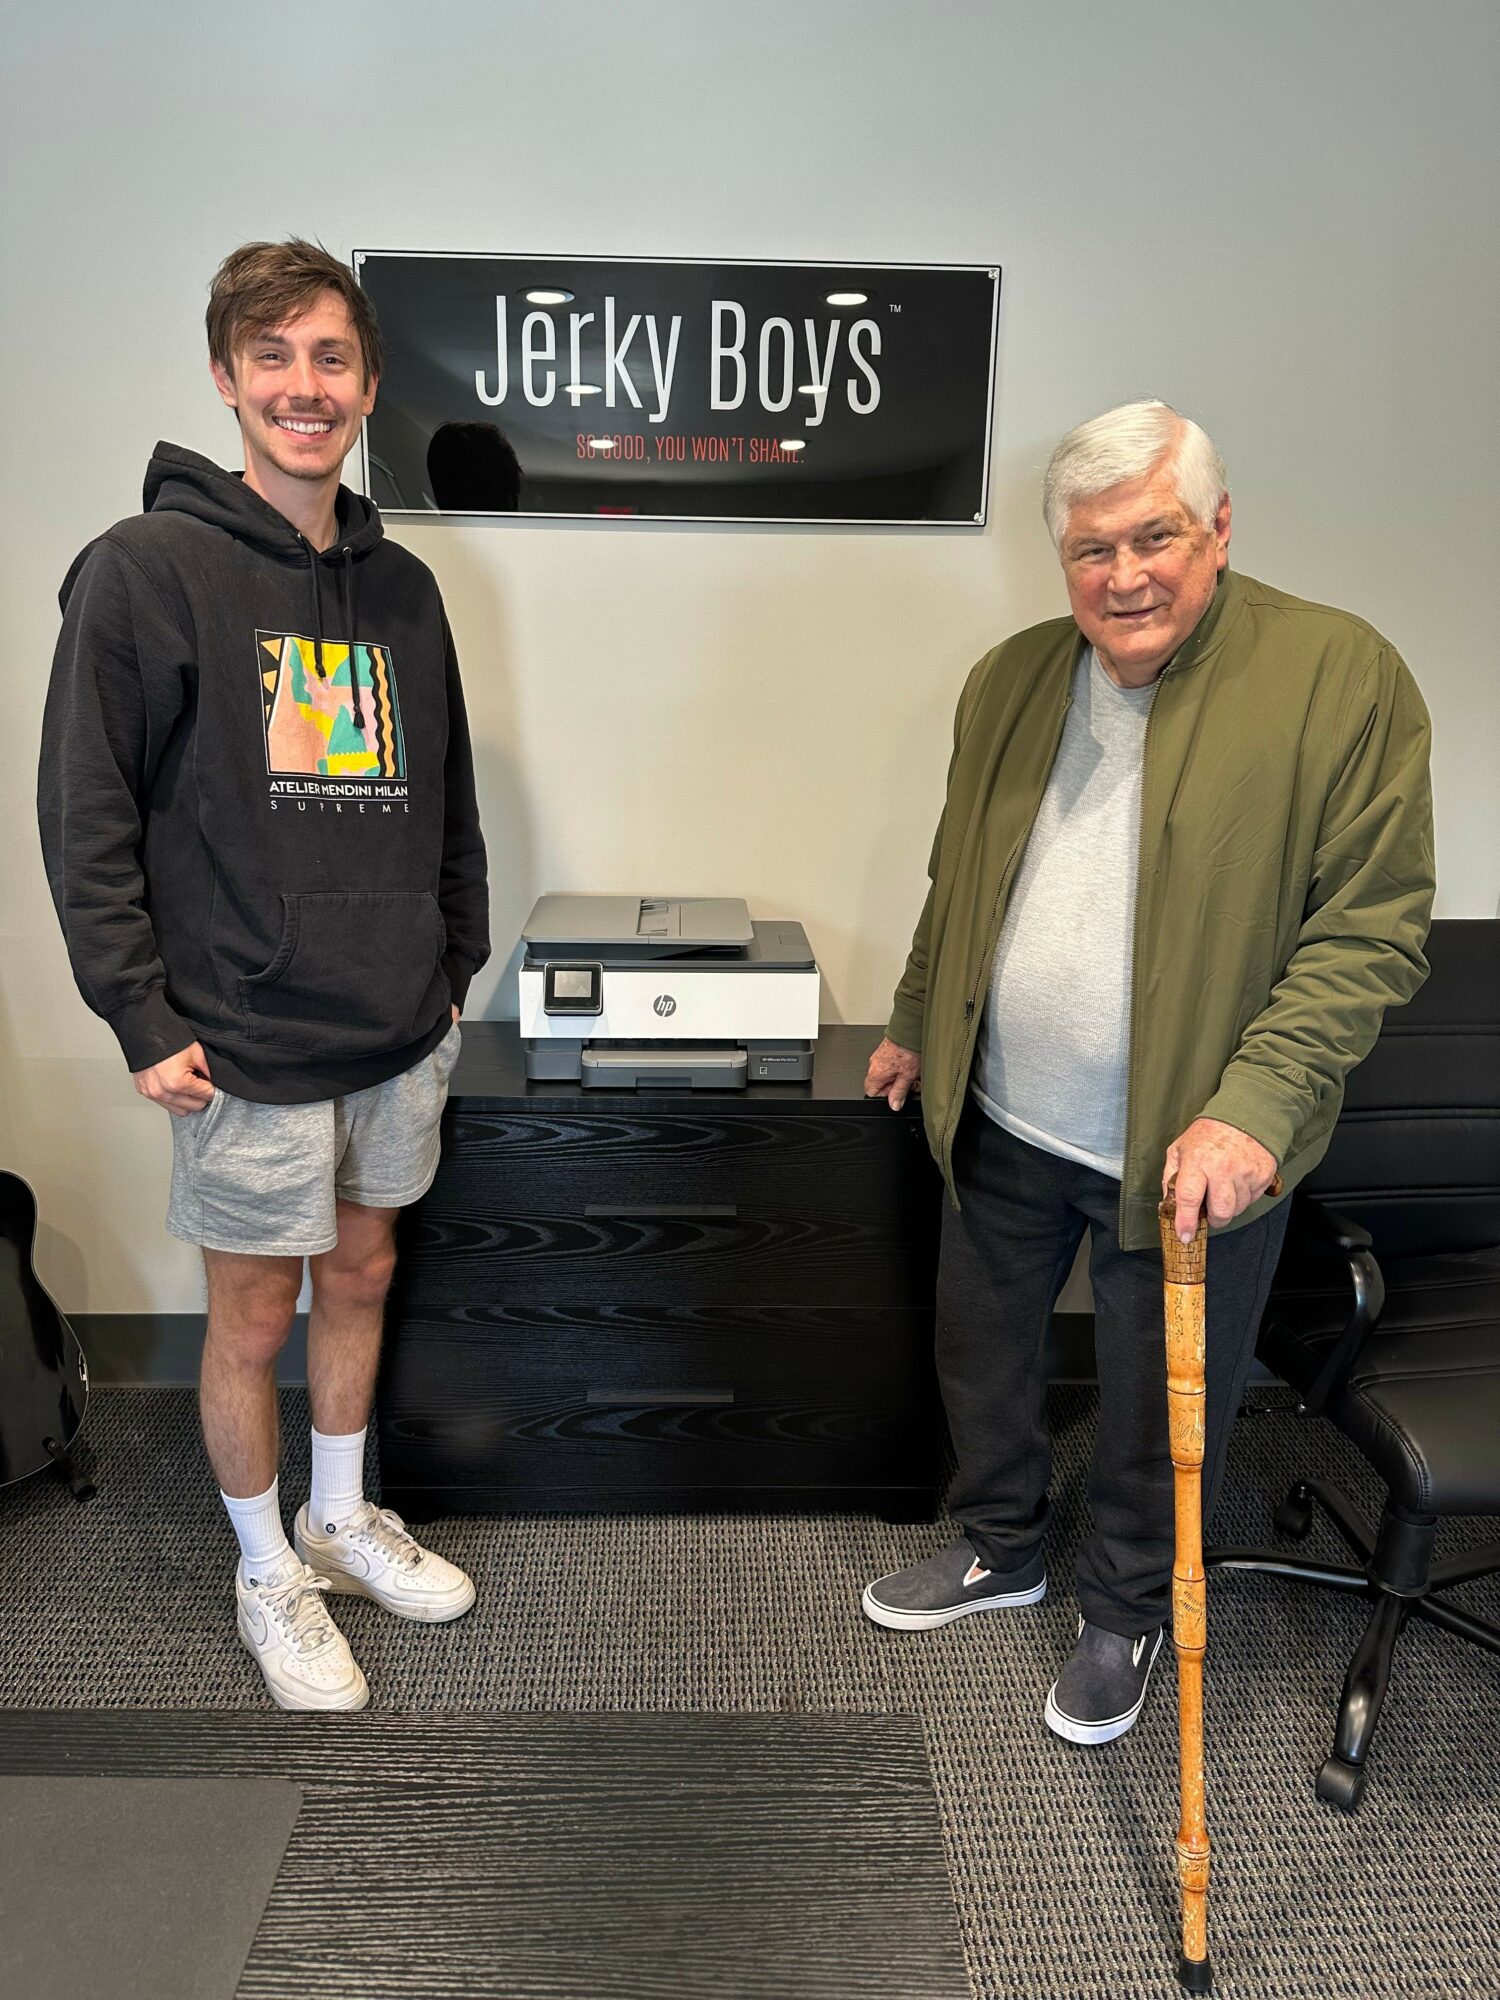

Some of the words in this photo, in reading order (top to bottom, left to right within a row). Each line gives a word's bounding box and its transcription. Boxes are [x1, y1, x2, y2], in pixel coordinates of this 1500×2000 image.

[889, 304, 902, 313] TM
[475, 295, 682, 423] Jerky
[710, 300, 882, 427] Boys
[576, 433, 596, 459] SO
[655, 435, 686, 462] YOU
[692, 436, 744, 463] WON'T
[269, 781, 320, 795] ATELIER
[321, 784, 371, 796] MENDINI
[375, 785, 408, 797] MILAN
[270, 800, 409, 813] SUPREME
[655, 995, 675, 1017] hp
